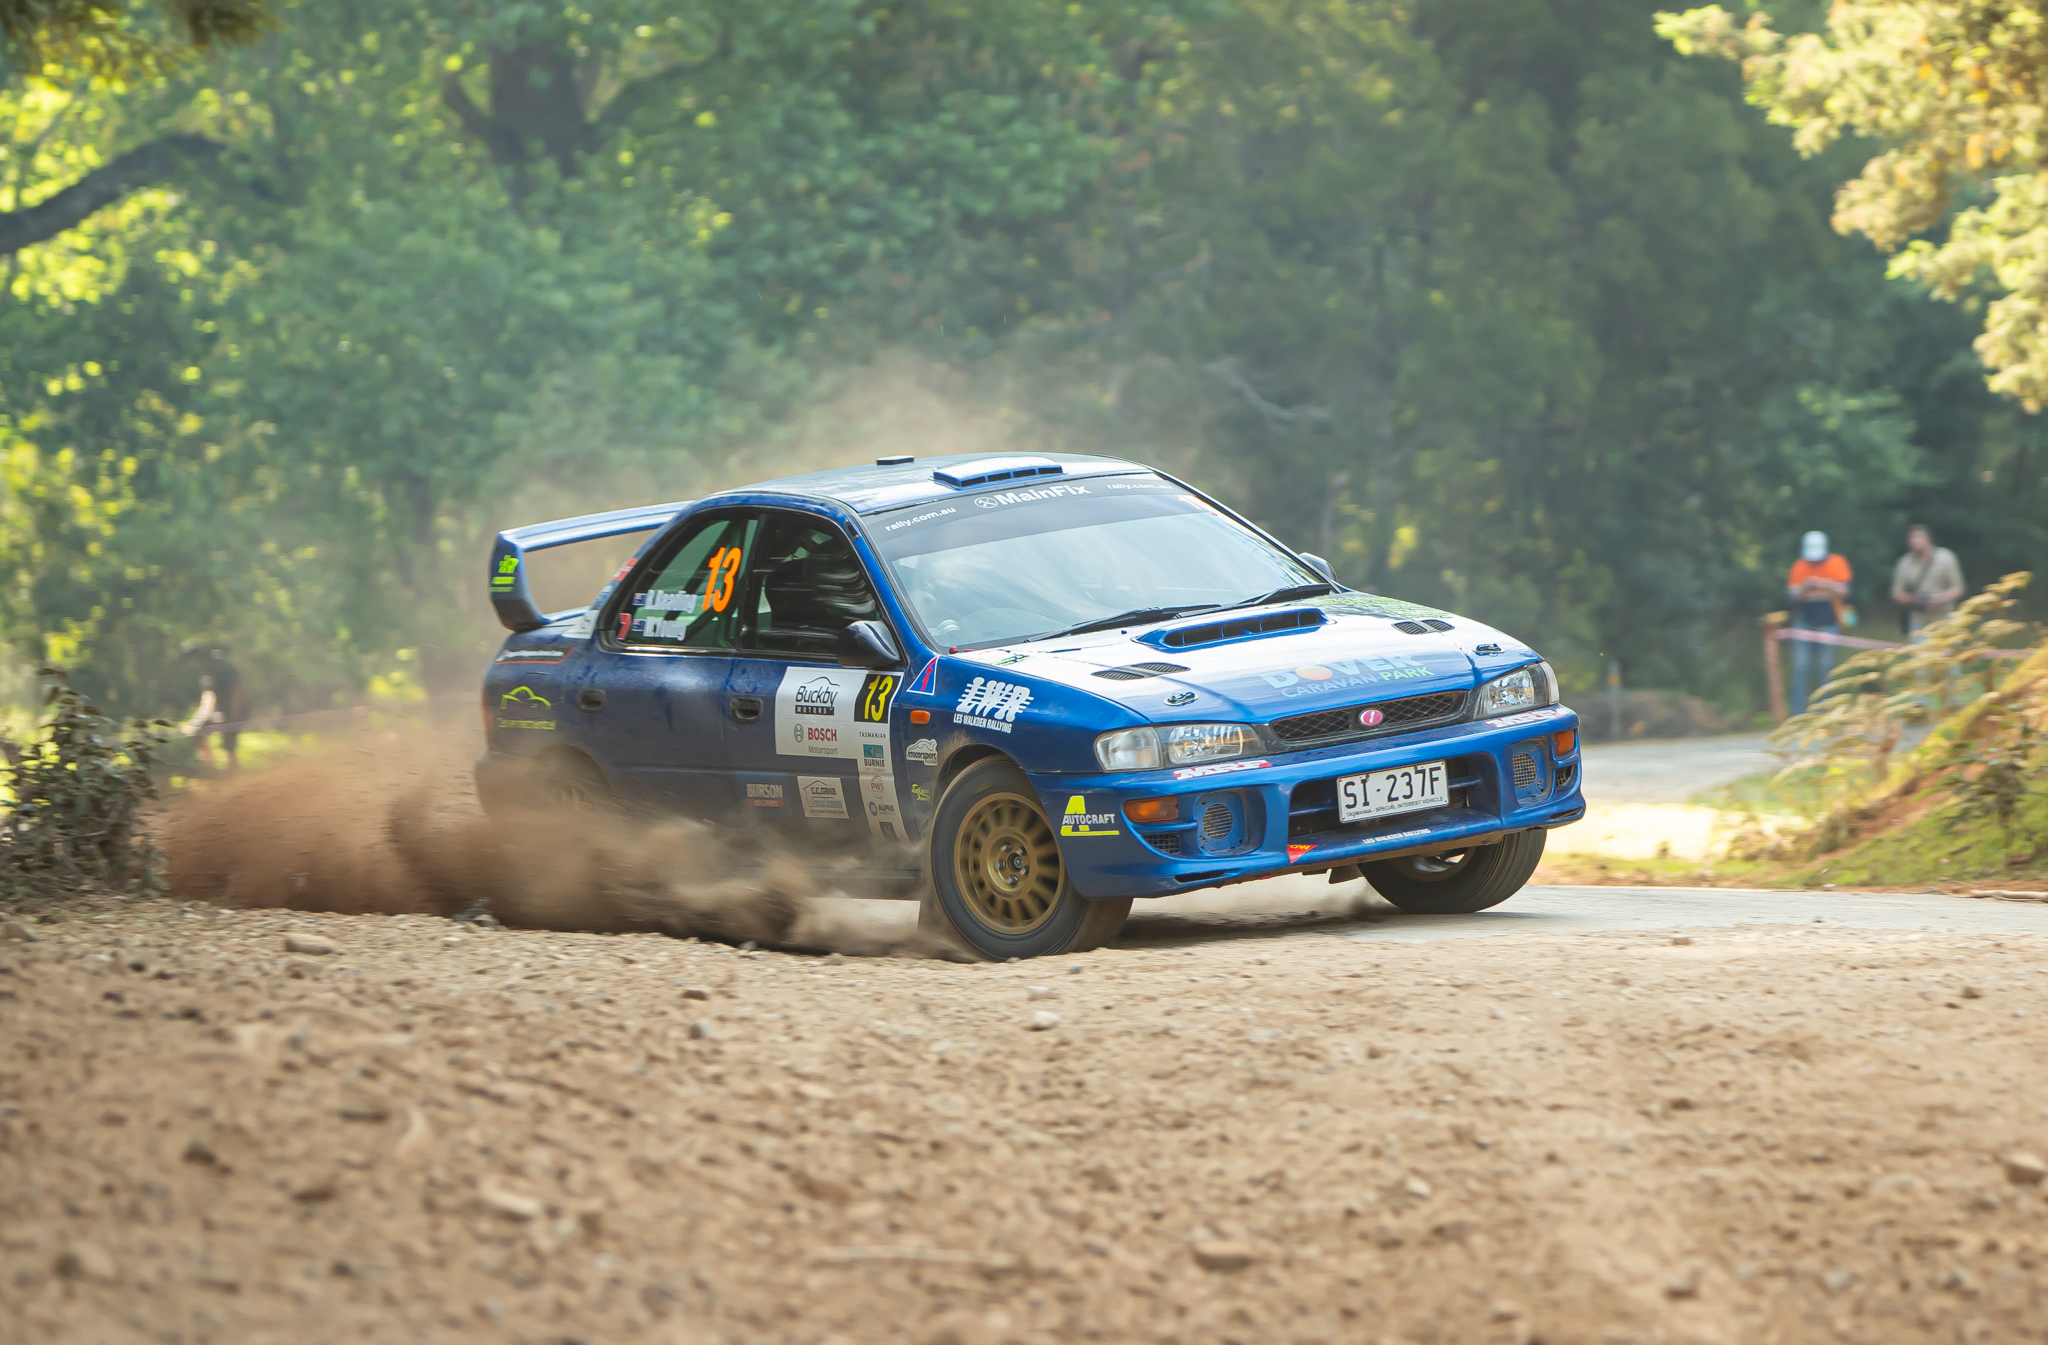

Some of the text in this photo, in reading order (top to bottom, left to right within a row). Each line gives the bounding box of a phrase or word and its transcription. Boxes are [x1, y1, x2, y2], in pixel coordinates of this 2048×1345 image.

[997, 483, 1092, 506] MainFix
[884, 507, 957, 532] rally.com.au
[702, 546, 742, 613] 13
[1258, 653, 1426, 689] DOVER
[1280, 665, 1435, 698] CARAVAN PARK
[795, 685, 838, 708] Buckby
[864, 675, 894, 722] 13
[955, 676, 1034, 723] LWR
[796, 706, 827, 715] MOTORS
[953, 713, 1013, 734] LES WALKDEN RALLYING
[807, 727, 838, 742] BOSCH
[859, 731, 887, 739] TASMANIAN
[808, 745, 838, 756] Motorsport
[864, 758, 885, 768] BURNIE
[1174, 759, 1270, 781] MRF
[746, 783, 783, 799] BURSON
[870, 782, 885, 792] PWS
[878, 804, 895, 813] ALPHA
[1375, 804, 1396, 812] SPECIAL
[1397, 799, 1421, 808] INTEREST
[1422, 796, 1444, 805] VEHICLE
[1062, 813, 1116, 826] AUTOCRAFT
